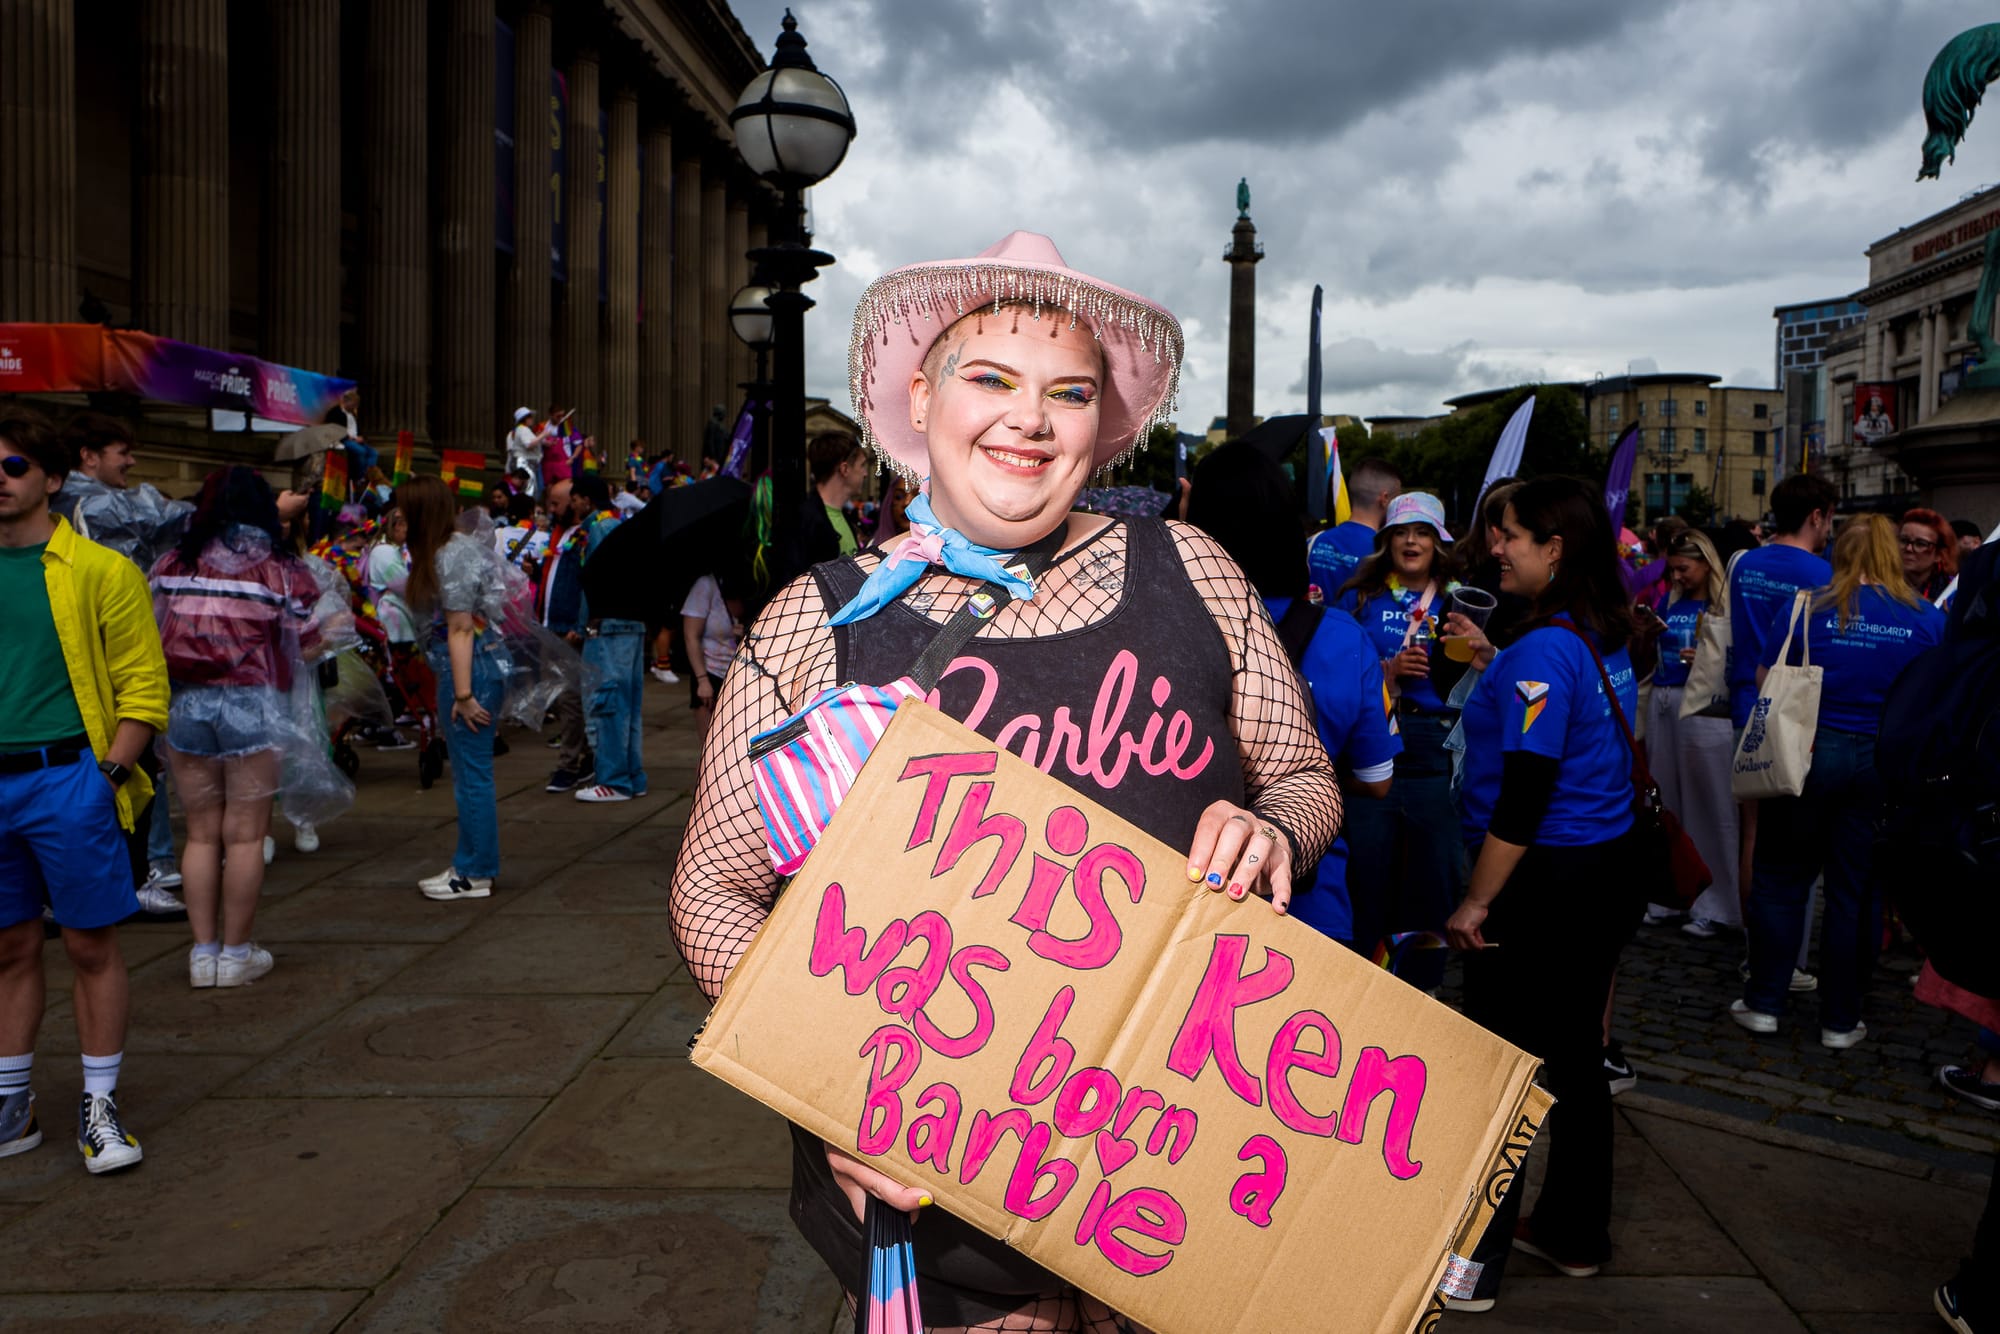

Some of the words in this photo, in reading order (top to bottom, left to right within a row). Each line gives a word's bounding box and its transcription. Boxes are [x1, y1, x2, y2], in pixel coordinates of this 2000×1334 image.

[220, 374, 251, 396] PRIDE
[267, 378, 297, 404] PRIDE
[809, 882, 1010, 1059] was
[1009, 985, 1198, 1165] born
[1229, 1134, 1288, 1228] a
[897, 751, 1147, 970] This
[1166, 933, 1427, 1180] Ken
[857, 1024, 1187, 1277] Barbie
